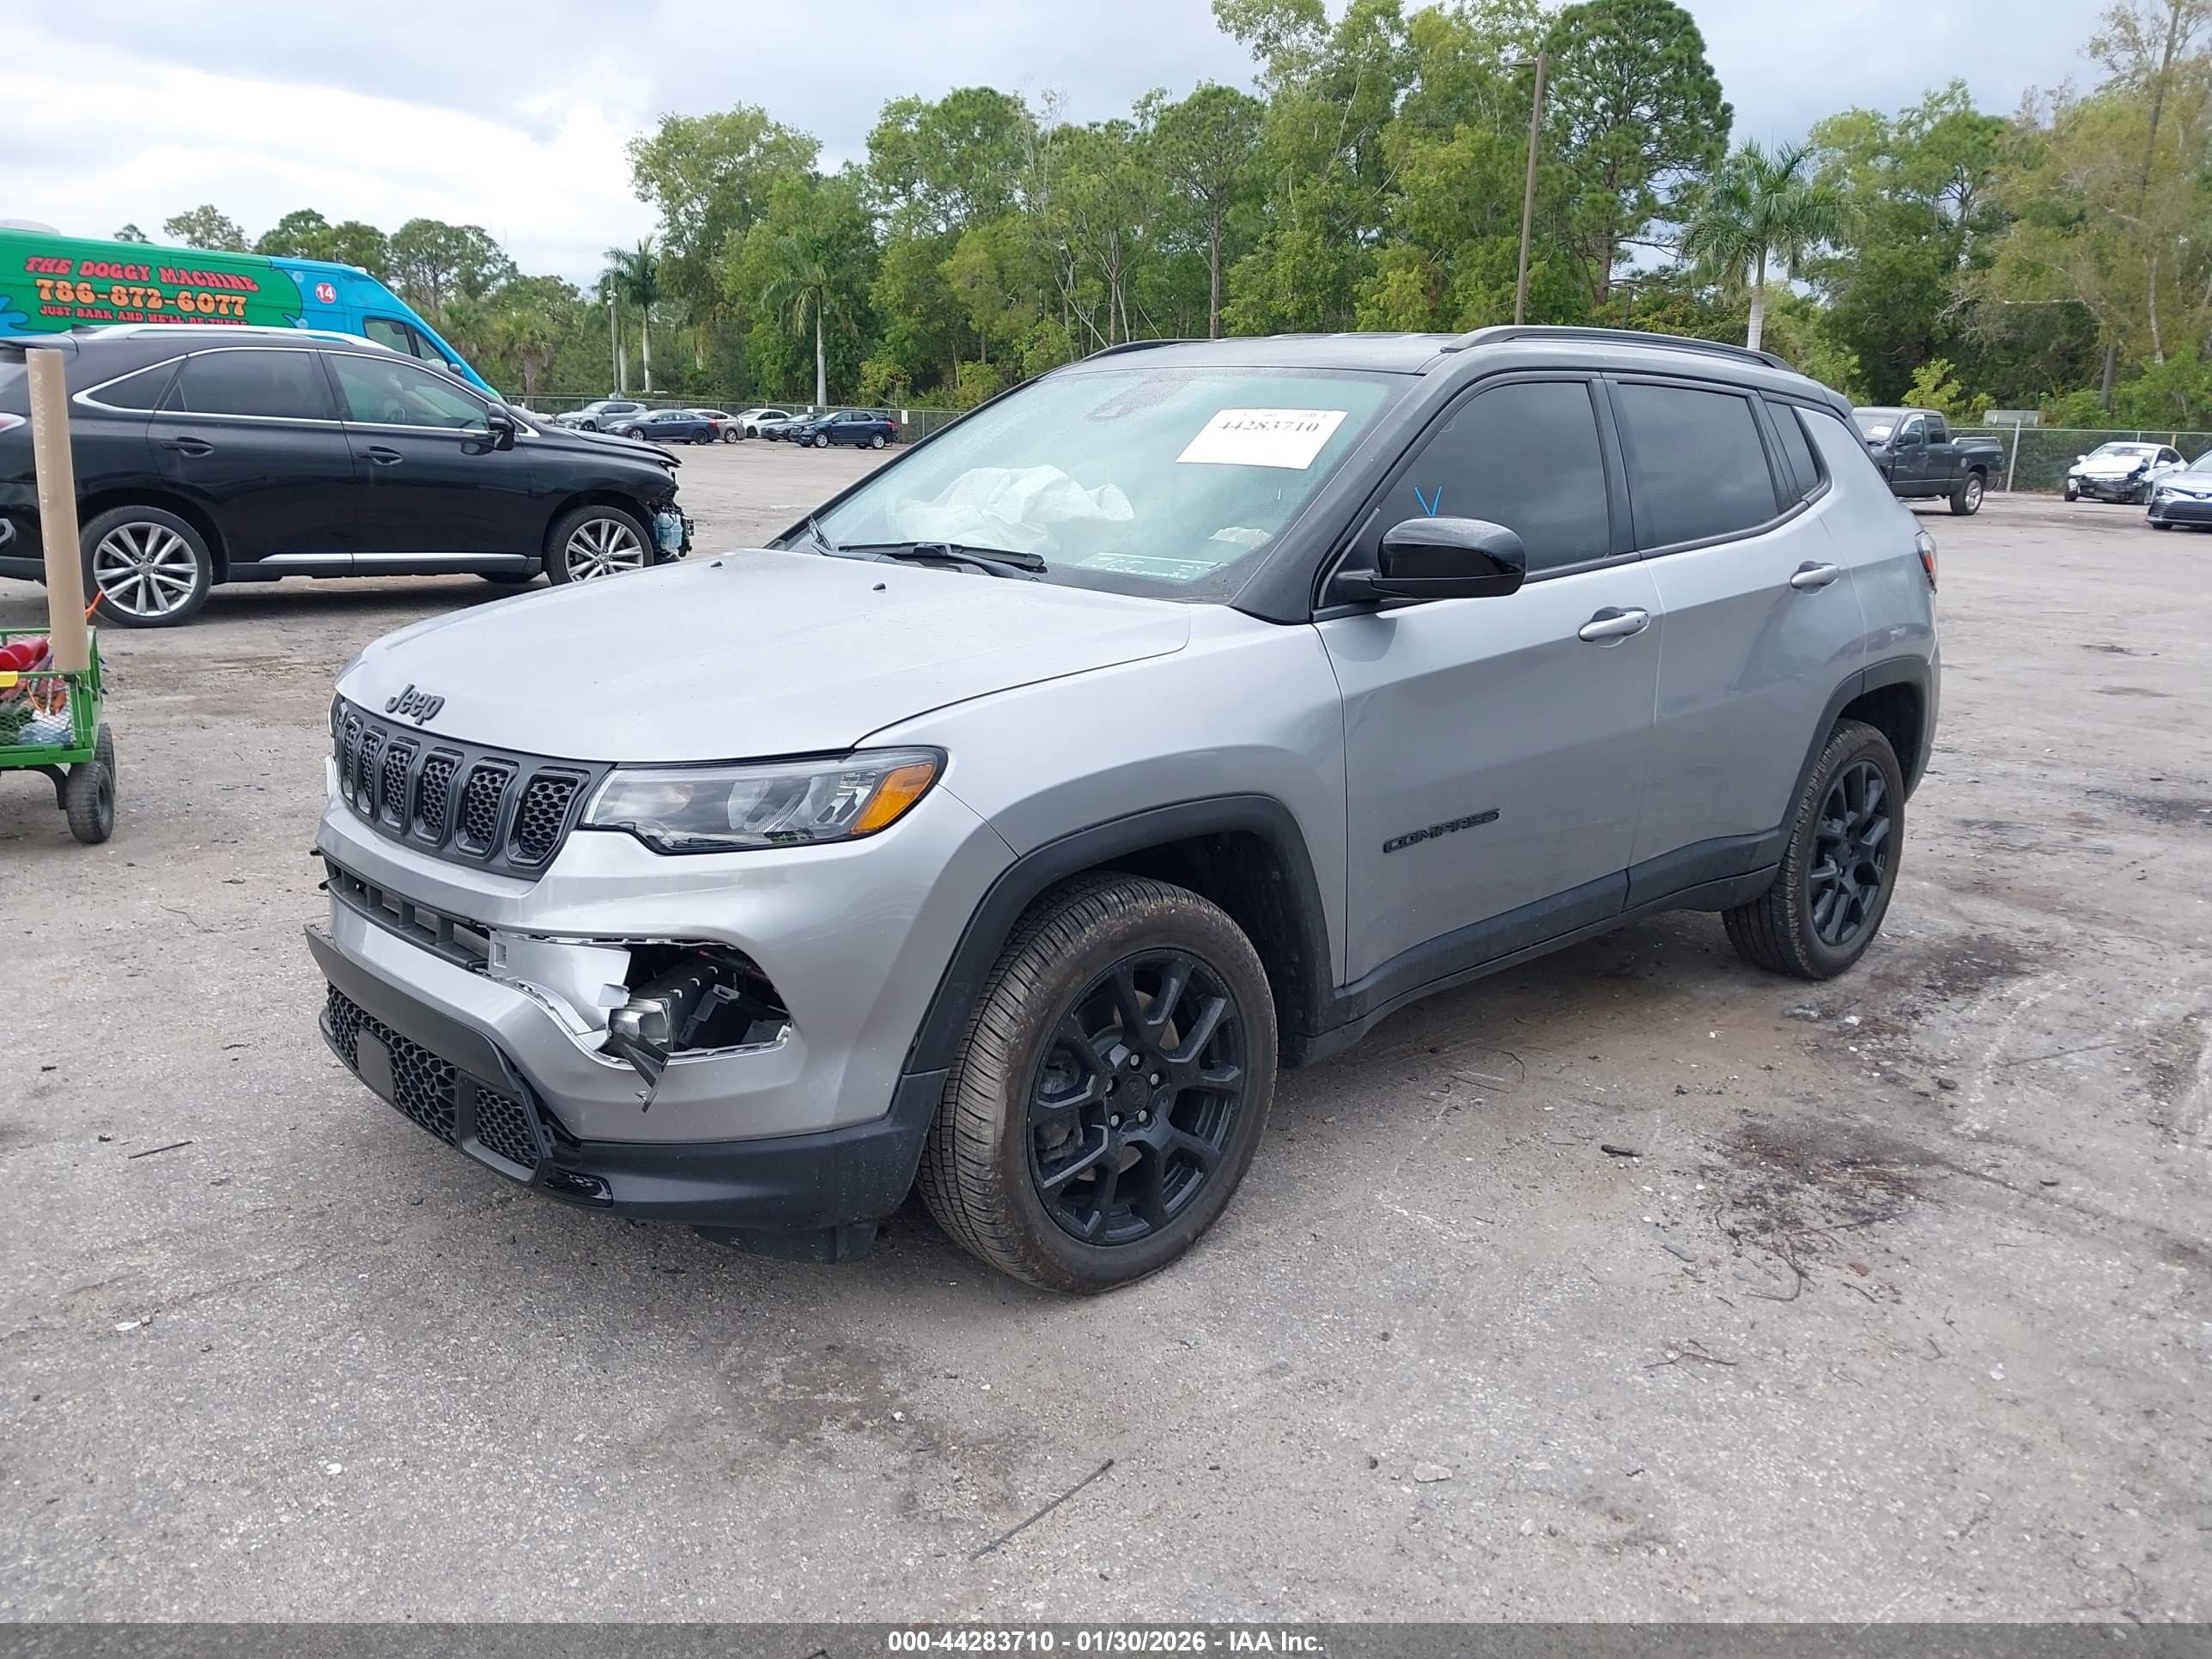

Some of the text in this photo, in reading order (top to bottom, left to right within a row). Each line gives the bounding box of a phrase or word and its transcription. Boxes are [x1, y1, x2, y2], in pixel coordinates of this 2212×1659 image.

[26, 256, 259, 292] THE DOGGY MACHINE
[35, 278, 246, 316] 786-872-6077
[317, 285, 334, 301] 14
[40, 305, 72, 317] JUST
[76, 307, 113, 320] BARK
[117, 310, 144, 322] AND
[147, 313, 185, 324] WE'LL
[384, 683, 446, 726] Jeep
[1382, 808, 1500, 854] COMPASS
